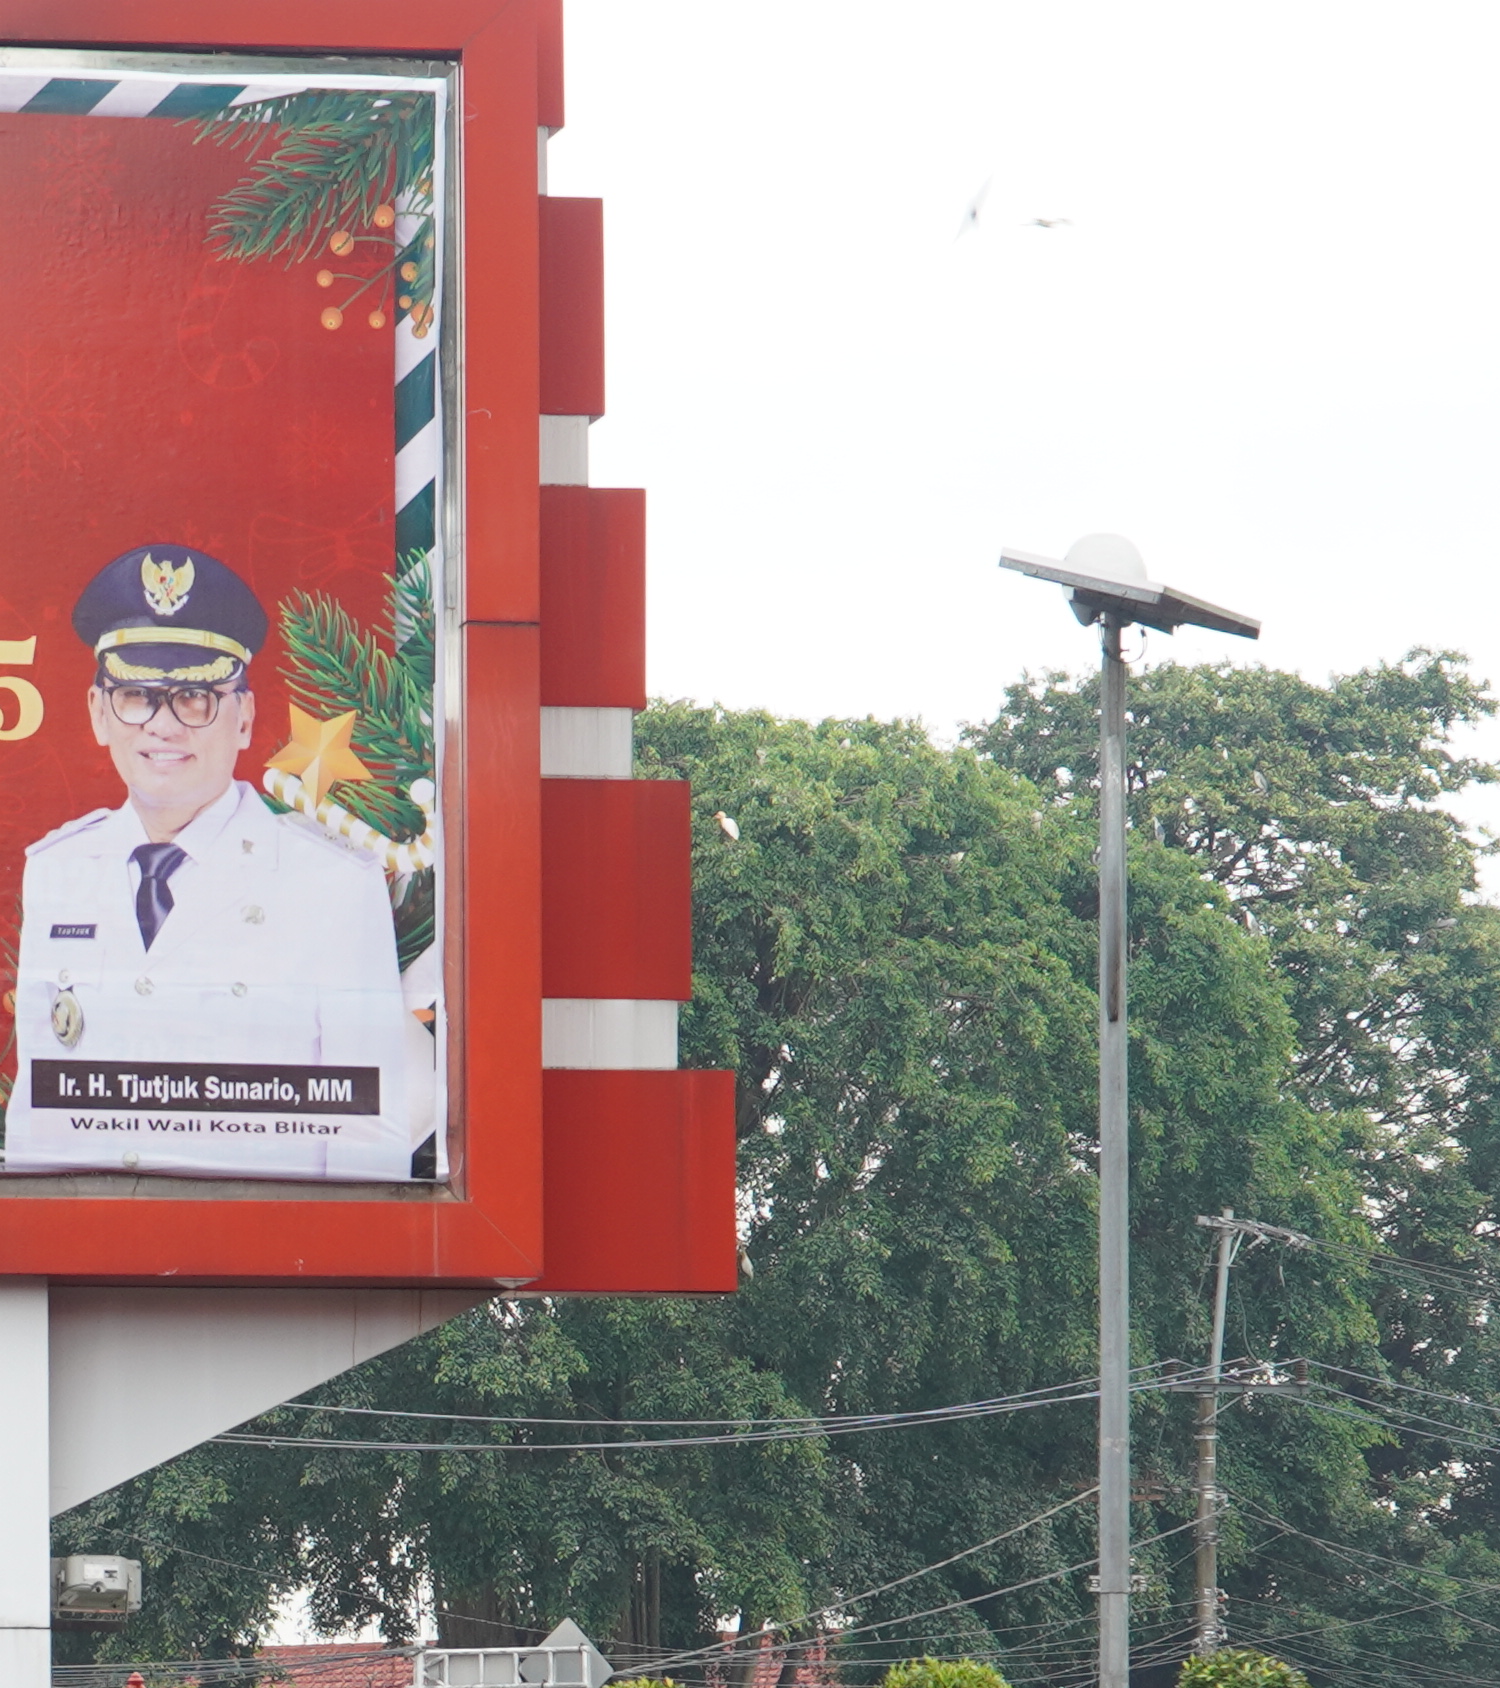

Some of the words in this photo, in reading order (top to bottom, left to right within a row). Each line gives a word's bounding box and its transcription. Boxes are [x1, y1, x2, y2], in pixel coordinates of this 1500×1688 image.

[58, 1073, 82, 1097] Ir.
[88, 1073, 112, 1097] H.
[117, 1074, 200, 1104] Tjutjuk
[204, 1075, 301, 1106] Sunario,
[307, 1078, 353, 1102] MM
[70, 1117, 140, 1131] Wakil
[148, 1118, 201, 1132] Wali
[210, 1119, 266, 1134] Kota
[275, 1121, 343, 1136] Blitar
